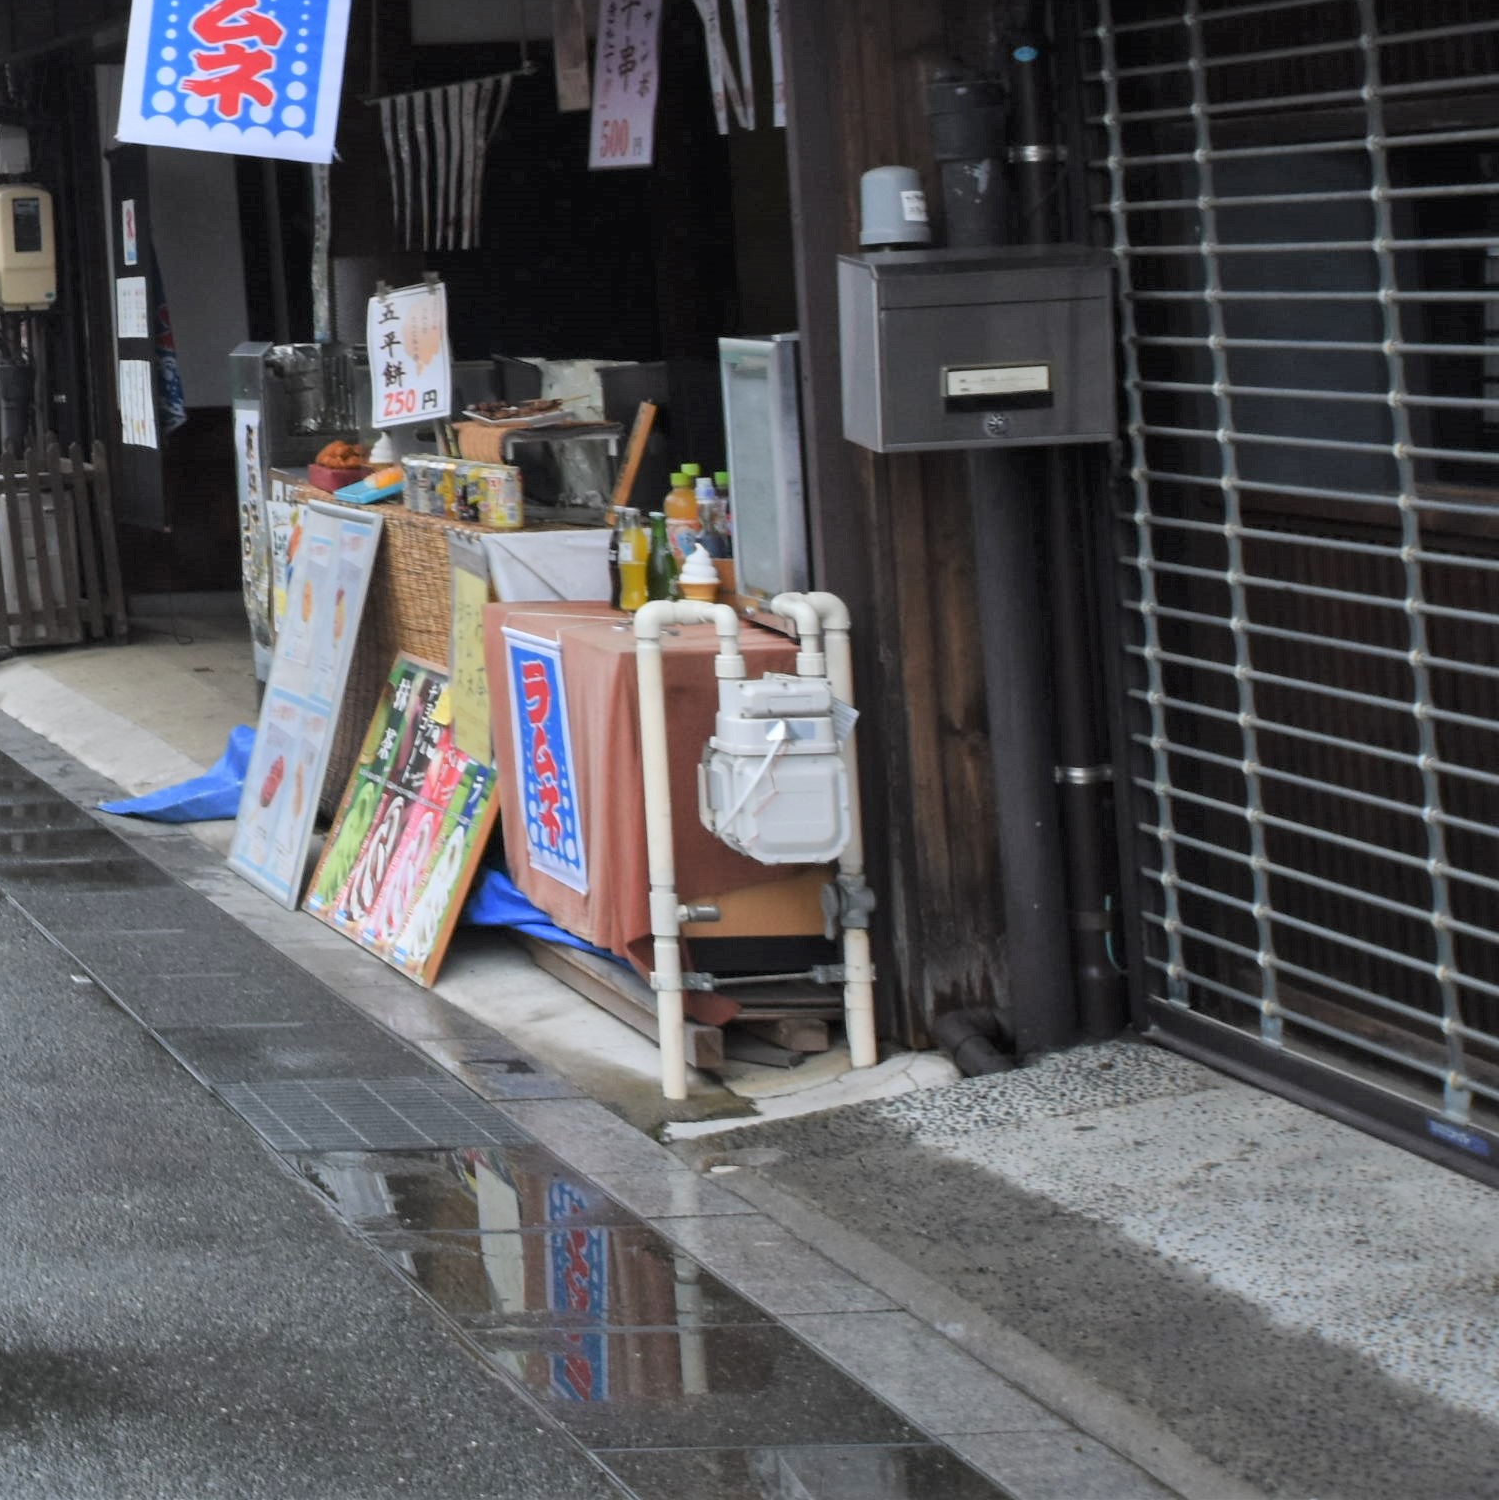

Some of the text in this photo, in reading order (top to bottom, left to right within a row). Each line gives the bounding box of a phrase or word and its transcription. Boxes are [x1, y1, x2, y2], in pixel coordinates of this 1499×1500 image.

[379, 302, 405, 388] 五平餅
[384, 389, 437, 417] 250円
[377, 677, 412, 761] 抹茶
[520, 660, 563, 850] ラムネ
